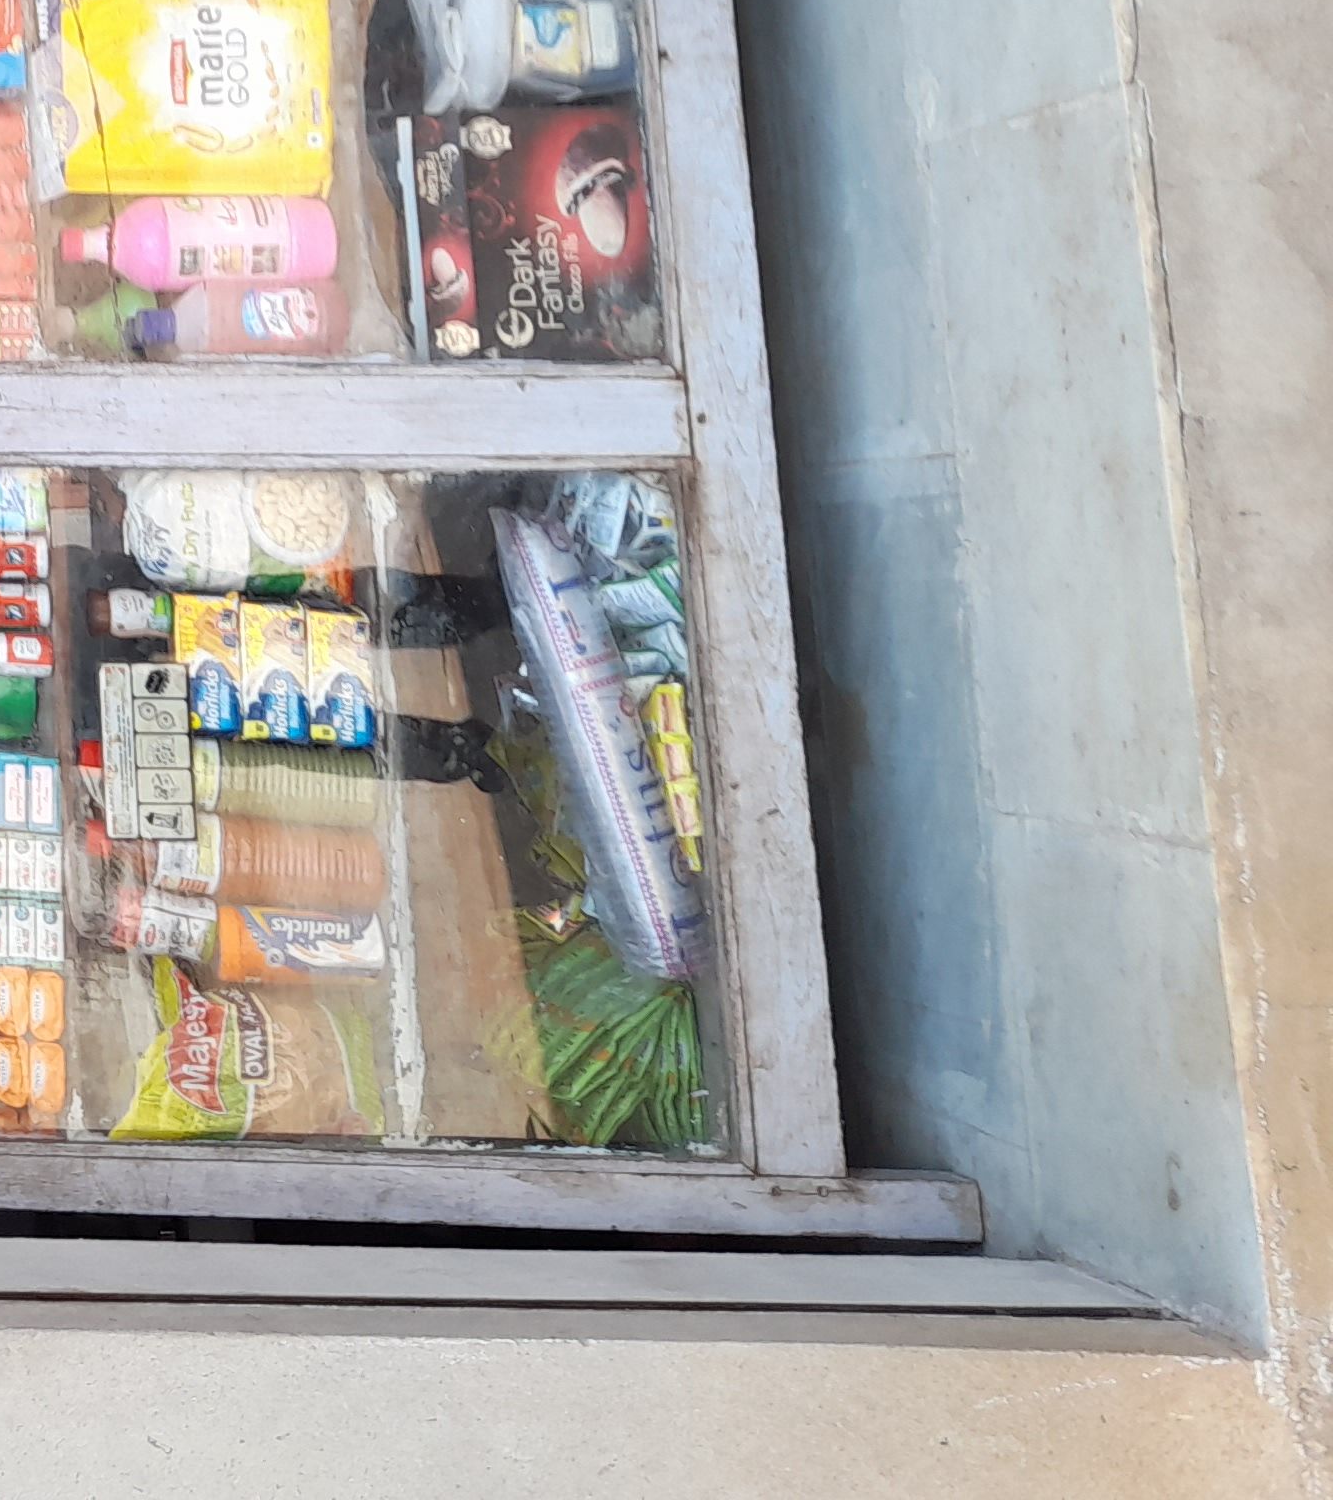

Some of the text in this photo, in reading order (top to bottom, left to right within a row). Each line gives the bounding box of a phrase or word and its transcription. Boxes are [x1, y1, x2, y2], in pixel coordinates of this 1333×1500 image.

[193, 6, 224, 107] marie
[225, 27, 250, 108] GOLD
[503, 237, 537, 308] Dark
[534, 213, 566, 329] Fantasy
[561, 231, 585, 314] Choco Fills
[180, 482, 195, 521] Fruits
[183, 527, 199, 557] Dry
[201, 668, 221, 730] Horlicks
[273, 678, 290, 740] Horlicks
[338, 682, 356, 743] Horlicks
[270, 917, 351, 941] Horlicks
[243, 1027, 265, 1077] OVAL
